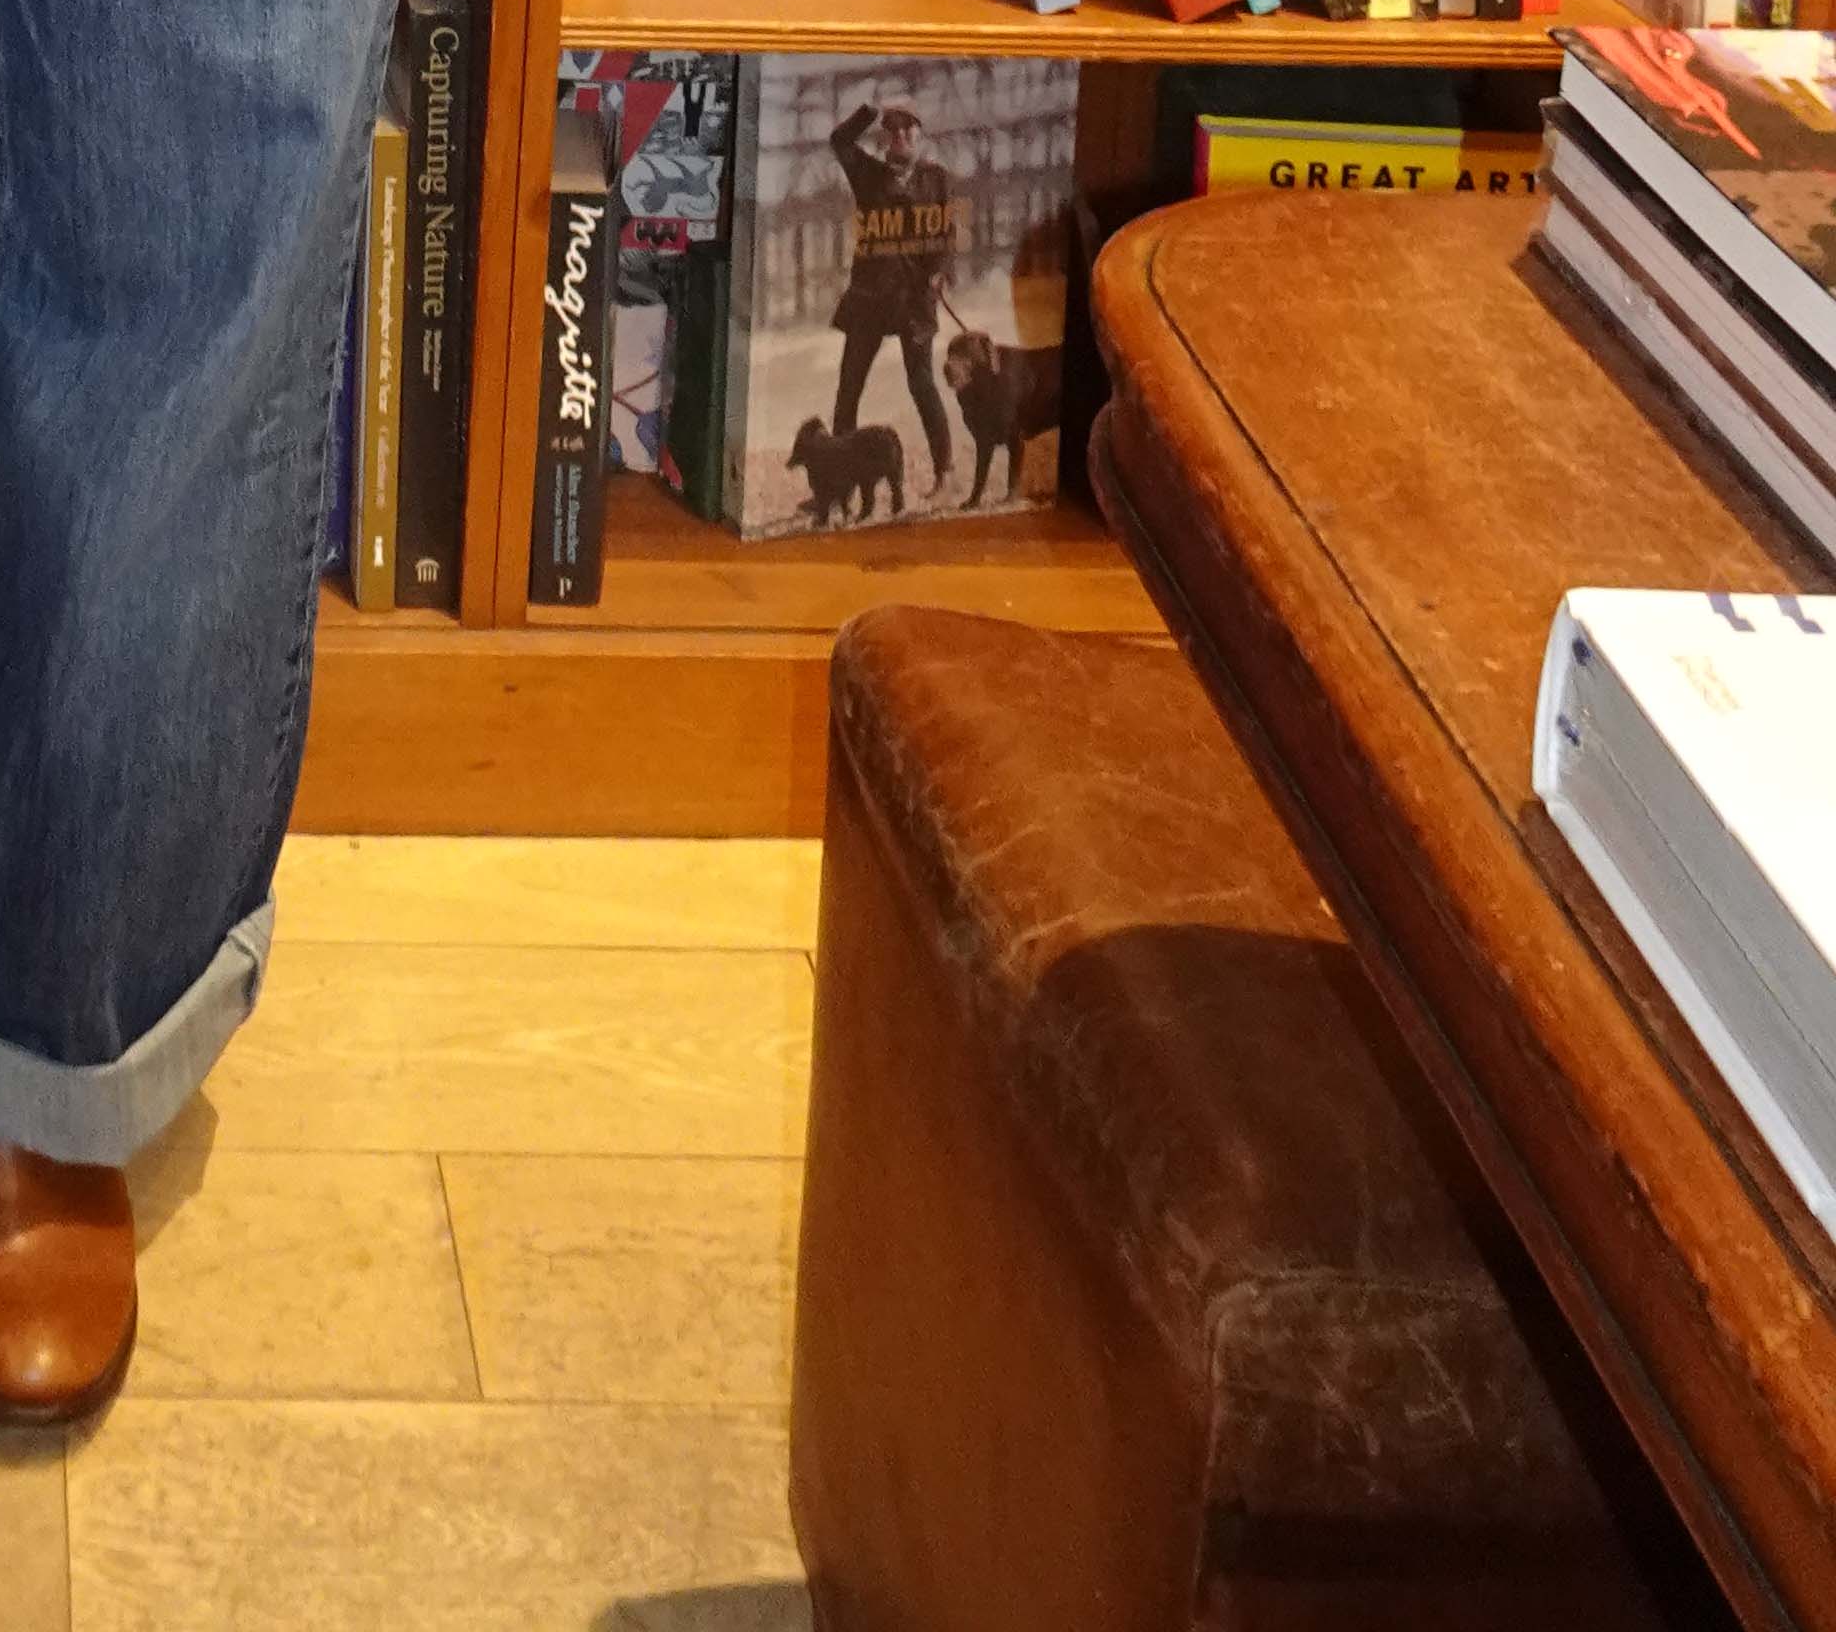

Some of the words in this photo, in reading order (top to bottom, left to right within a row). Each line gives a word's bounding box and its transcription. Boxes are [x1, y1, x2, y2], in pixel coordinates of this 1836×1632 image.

[417, 27, 460, 195] Capturing
[1270, 160, 1426, 189] GREAT
[422, 202, 454, 317] Nature
